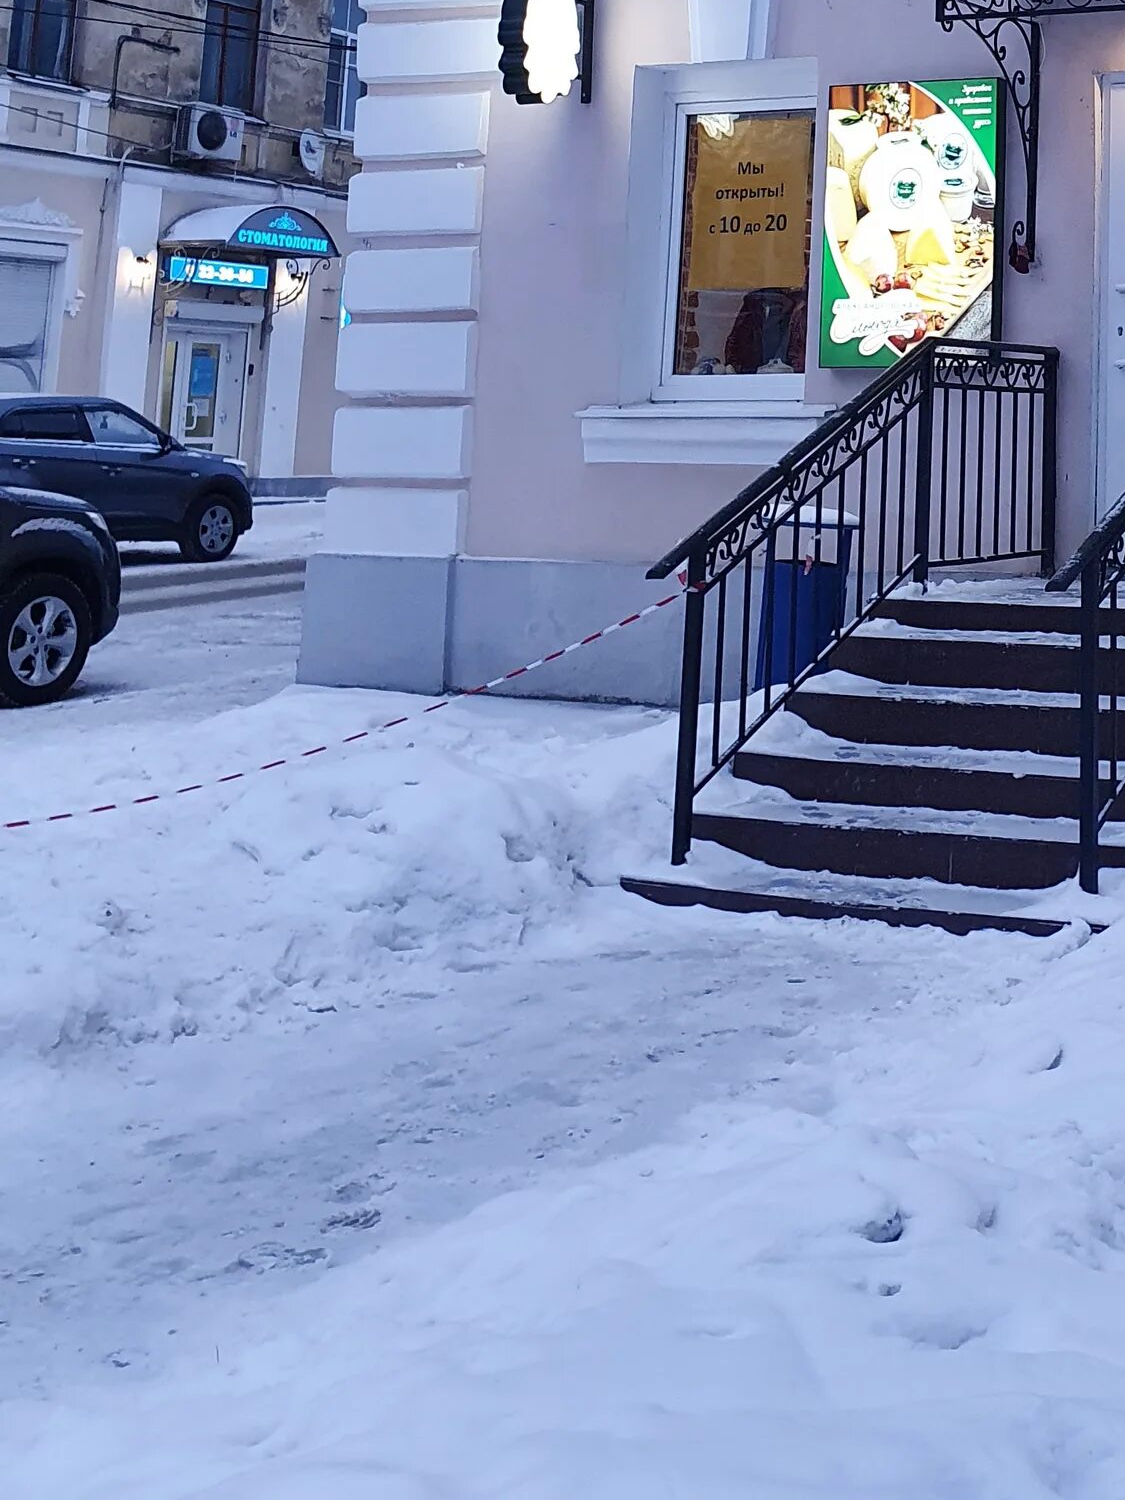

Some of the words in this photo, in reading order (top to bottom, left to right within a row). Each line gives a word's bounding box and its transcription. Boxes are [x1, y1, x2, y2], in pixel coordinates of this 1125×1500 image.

[737, 161, 764, 175] Мы
[715, 182, 784, 202] открыты!
[709, 224, 716, 234] с
[720, 215, 741, 234] 10
[743, 222, 761, 235] до
[765, 213, 788, 232] 20
[238, 228, 329, 253] СТОМАТОЛОГИЯ
